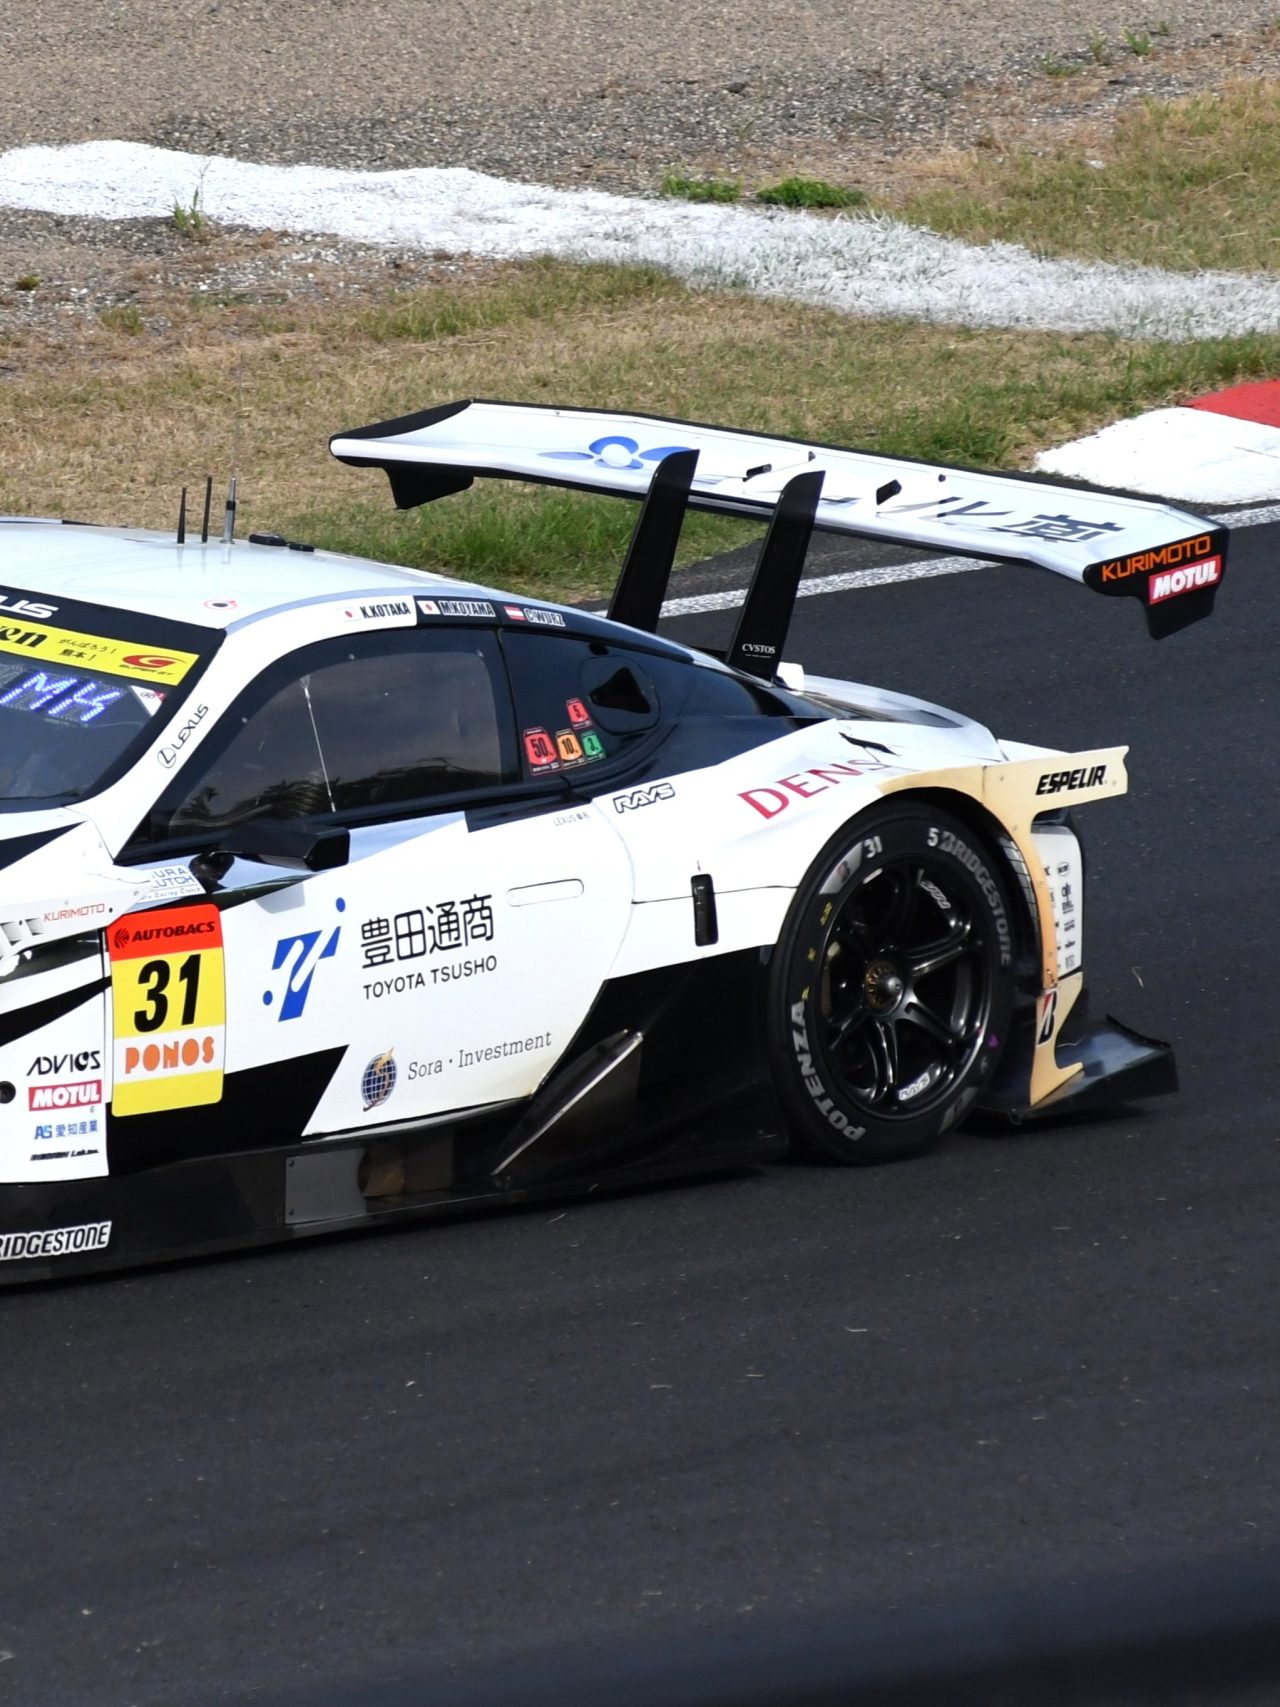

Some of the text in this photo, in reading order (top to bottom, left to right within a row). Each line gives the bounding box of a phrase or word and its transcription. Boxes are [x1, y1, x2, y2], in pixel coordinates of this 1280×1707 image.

[1102, 535, 1211, 582] KURIMOTO
[1152, 560, 1219, 600] MOTUL
[359, 602, 412, 618] K.KOTAKA
[171, 703, 210, 750] LEXUS
[612, 782, 676, 814] RAYS
[736, 759, 893, 820] DENS
[1035, 765, 1107, 796] ESPELIR
[863, 836, 883, 858] 31
[43, 903, 106, 923] KURIMOTO
[937, 830, 1012, 967] BRIDGESTONE
[132, 921, 216, 943] AUTOBACS
[360, 894, 495, 969] 豊田通商
[133, 953, 202, 1033] 31
[362, 954, 498, 1000] TOYOTA TSUSHO
[26, 1050, 102, 1077] ADVICS
[124, 1036, 216, 1075] PONOS
[407, 1030, 552, 1081] Sora Investment
[791, 1001, 867, 1142] POTENZA
[31, 1081, 101, 1109] MOTUL
